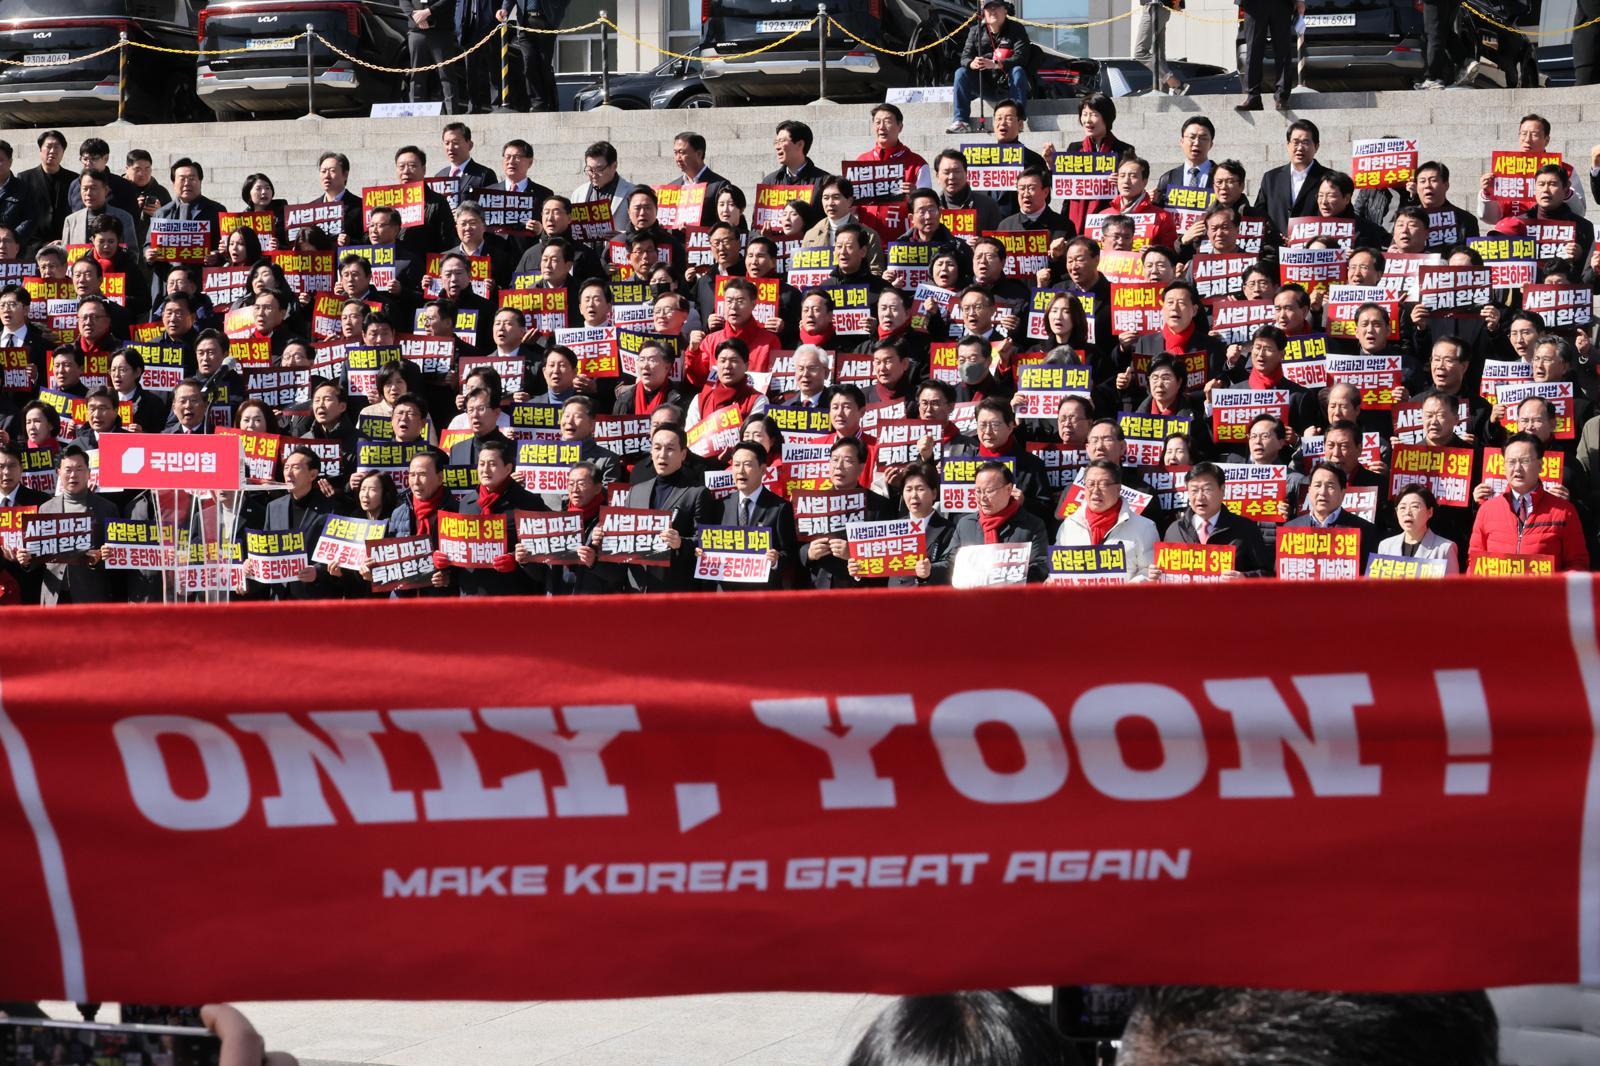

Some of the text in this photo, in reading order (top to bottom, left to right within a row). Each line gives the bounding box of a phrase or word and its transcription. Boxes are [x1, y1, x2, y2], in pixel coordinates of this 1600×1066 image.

[1003, 147, 1022, 163] 파괴
[1354, 140, 1405, 155] 사법파괴 악법
[847, 163, 904, 181] 사법 파괴
[1055, 155, 1116, 172] 삼권분립 파괴
[1357, 155, 1411, 171] 대한민국
[1494, 156, 1538, 175] 사법파괴
[434, 180, 459, 194] 파괴
[1055, 178, 1073, 196] 당장
[1355, 170, 1381, 187] 헌정
[365, 185, 422, 208] 사법파괴 3법
[478, 194, 533, 209] 사법 파괴
[1168, 189, 1207, 207] 삼권분립
[287, 207, 314, 226] 사법
[316, 204, 343, 222] 파괴
[506, 211, 533, 225] 완성
[593, 203, 611, 220] 3법
[1429, 211, 1456, 227] 파괴
[256, 216, 272, 232] 3법
[956, 214, 974, 232] 3법
[1290, 222, 1353, 240] 사법 파괴
[156, 233, 204, 246] 대한민국
[1543, 225, 1574, 241] 파괴
[1028, 236, 1047, 253] 3법
[1512, 239, 1535, 259] 파괴
[315, 255, 333, 273] 3법
[792, 250, 831, 268] 삼권분립
[889, 246, 929, 264] 삼권분립
[471, 260, 489, 278] 3법
[1198, 260, 1226, 278] 사법
[1286, 264, 1341, 281] 대한민국
[108, 278, 124, 295] 3법
[206, 272, 230, 289] 사법
[1423, 271, 1491, 290] 사법 파괴
[502, 292, 566, 311] 사법파괴 3법
[758, 283, 777, 301] 3법
[847, 287, 868, 307] 파괴
[1114, 288, 1156, 307] 사법파괴
[1332, 289, 1385, 302] 사법파괴 악법
[1422, 288, 1491, 312] 독재 완성
[1526, 288, 1591, 310] 사법 파괴
[456, 313, 476, 331] 파괴
[1217, 306, 1249, 325] 사법
[1557, 308, 1592, 328] 완성
[163, 348, 183, 365] 파괴
[251, 342, 270, 360] 3법
[425, 340, 452, 356] 파괴
[1304, 337, 1327, 358] 파괴
[12, 350, 27, 367] 3법
[91, 356, 109, 374] 3법
[424, 358, 451, 373] 완성
[494, 360, 523, 376] 파괴
[585, 357, 616, 373] 수호!
[1185, 355, 1205, 372] 3법
[1329, 359, 1386, 371] 사법파괴 악법
[840, 360, 872, 377] 사법
[247, 370, 309, 390] 사법 파괴
[1021, 368, 1089, 389] 삼권분립 파괴
[280, 386, 309, 405] 완성
[1215, 392, 1274, 406] 사법파괴 악법
[1537, 384, 1558, 398] 악법
[513, 406, 555, 426] 삼권분립
[721, 407, 741, 428] 3법
[881, 425, 909, 444] 사법
[259, 436, 278, 458] 3법
[360, 444, 402, 465] 삼권분립
[519, 444, 580, 464] 삼권분립 파괴
[785, 447, 822, 461] 사법파괴
[879, 445, 908, 464] 독재
[30, 450, 52, 469] 파괴
[150, 451, 216, 473] 국민의힘
[1394, 448, 1470, 477] 사법파괴 3법
[1251, 466, 1271, 480] 악법
[795, 492, 865, 515] 사법 파괴
[943, 489, 964, 509] 당장
[25, 517, 92, 538] 사법 파괴
[440, 516, 504, 540] 사법파괴 3법
[520, 515, 582, 535] 사법 파괴
[603, 514, 670, 532] 사법 파괴
[849, 522, 909, 541] 사법파괴 악법
[106, 522, 147, 544] 삼권분립
[282, 531, 304, 552] 파괴
[701, 528, 770, 551] 삼권분립 파괴
[26, 534, 92, 558] 독재 완성
[371, 538, 431, 562] 사법 파괴
[550, 534, 582, 553] 완성
[602, 535, 635, 555] 독재
[857, 537, 918, 558] 대한민국
[1280, 532, 1357, 556] 사법파괴 3법
[698, 555, 768, 579] 당장 중단하라!
[1051, 549, 1124, 572] 삼권분립 파괴
[1157, 547, 1232, 573] 사법파괴 3법
[371, 556, 435, 584] 독재 완성
[113, 669, 1492, 832] ONLY, YOON !
[383, 848, 1191, 898] MAKE KOREA GREAT AGAIN
